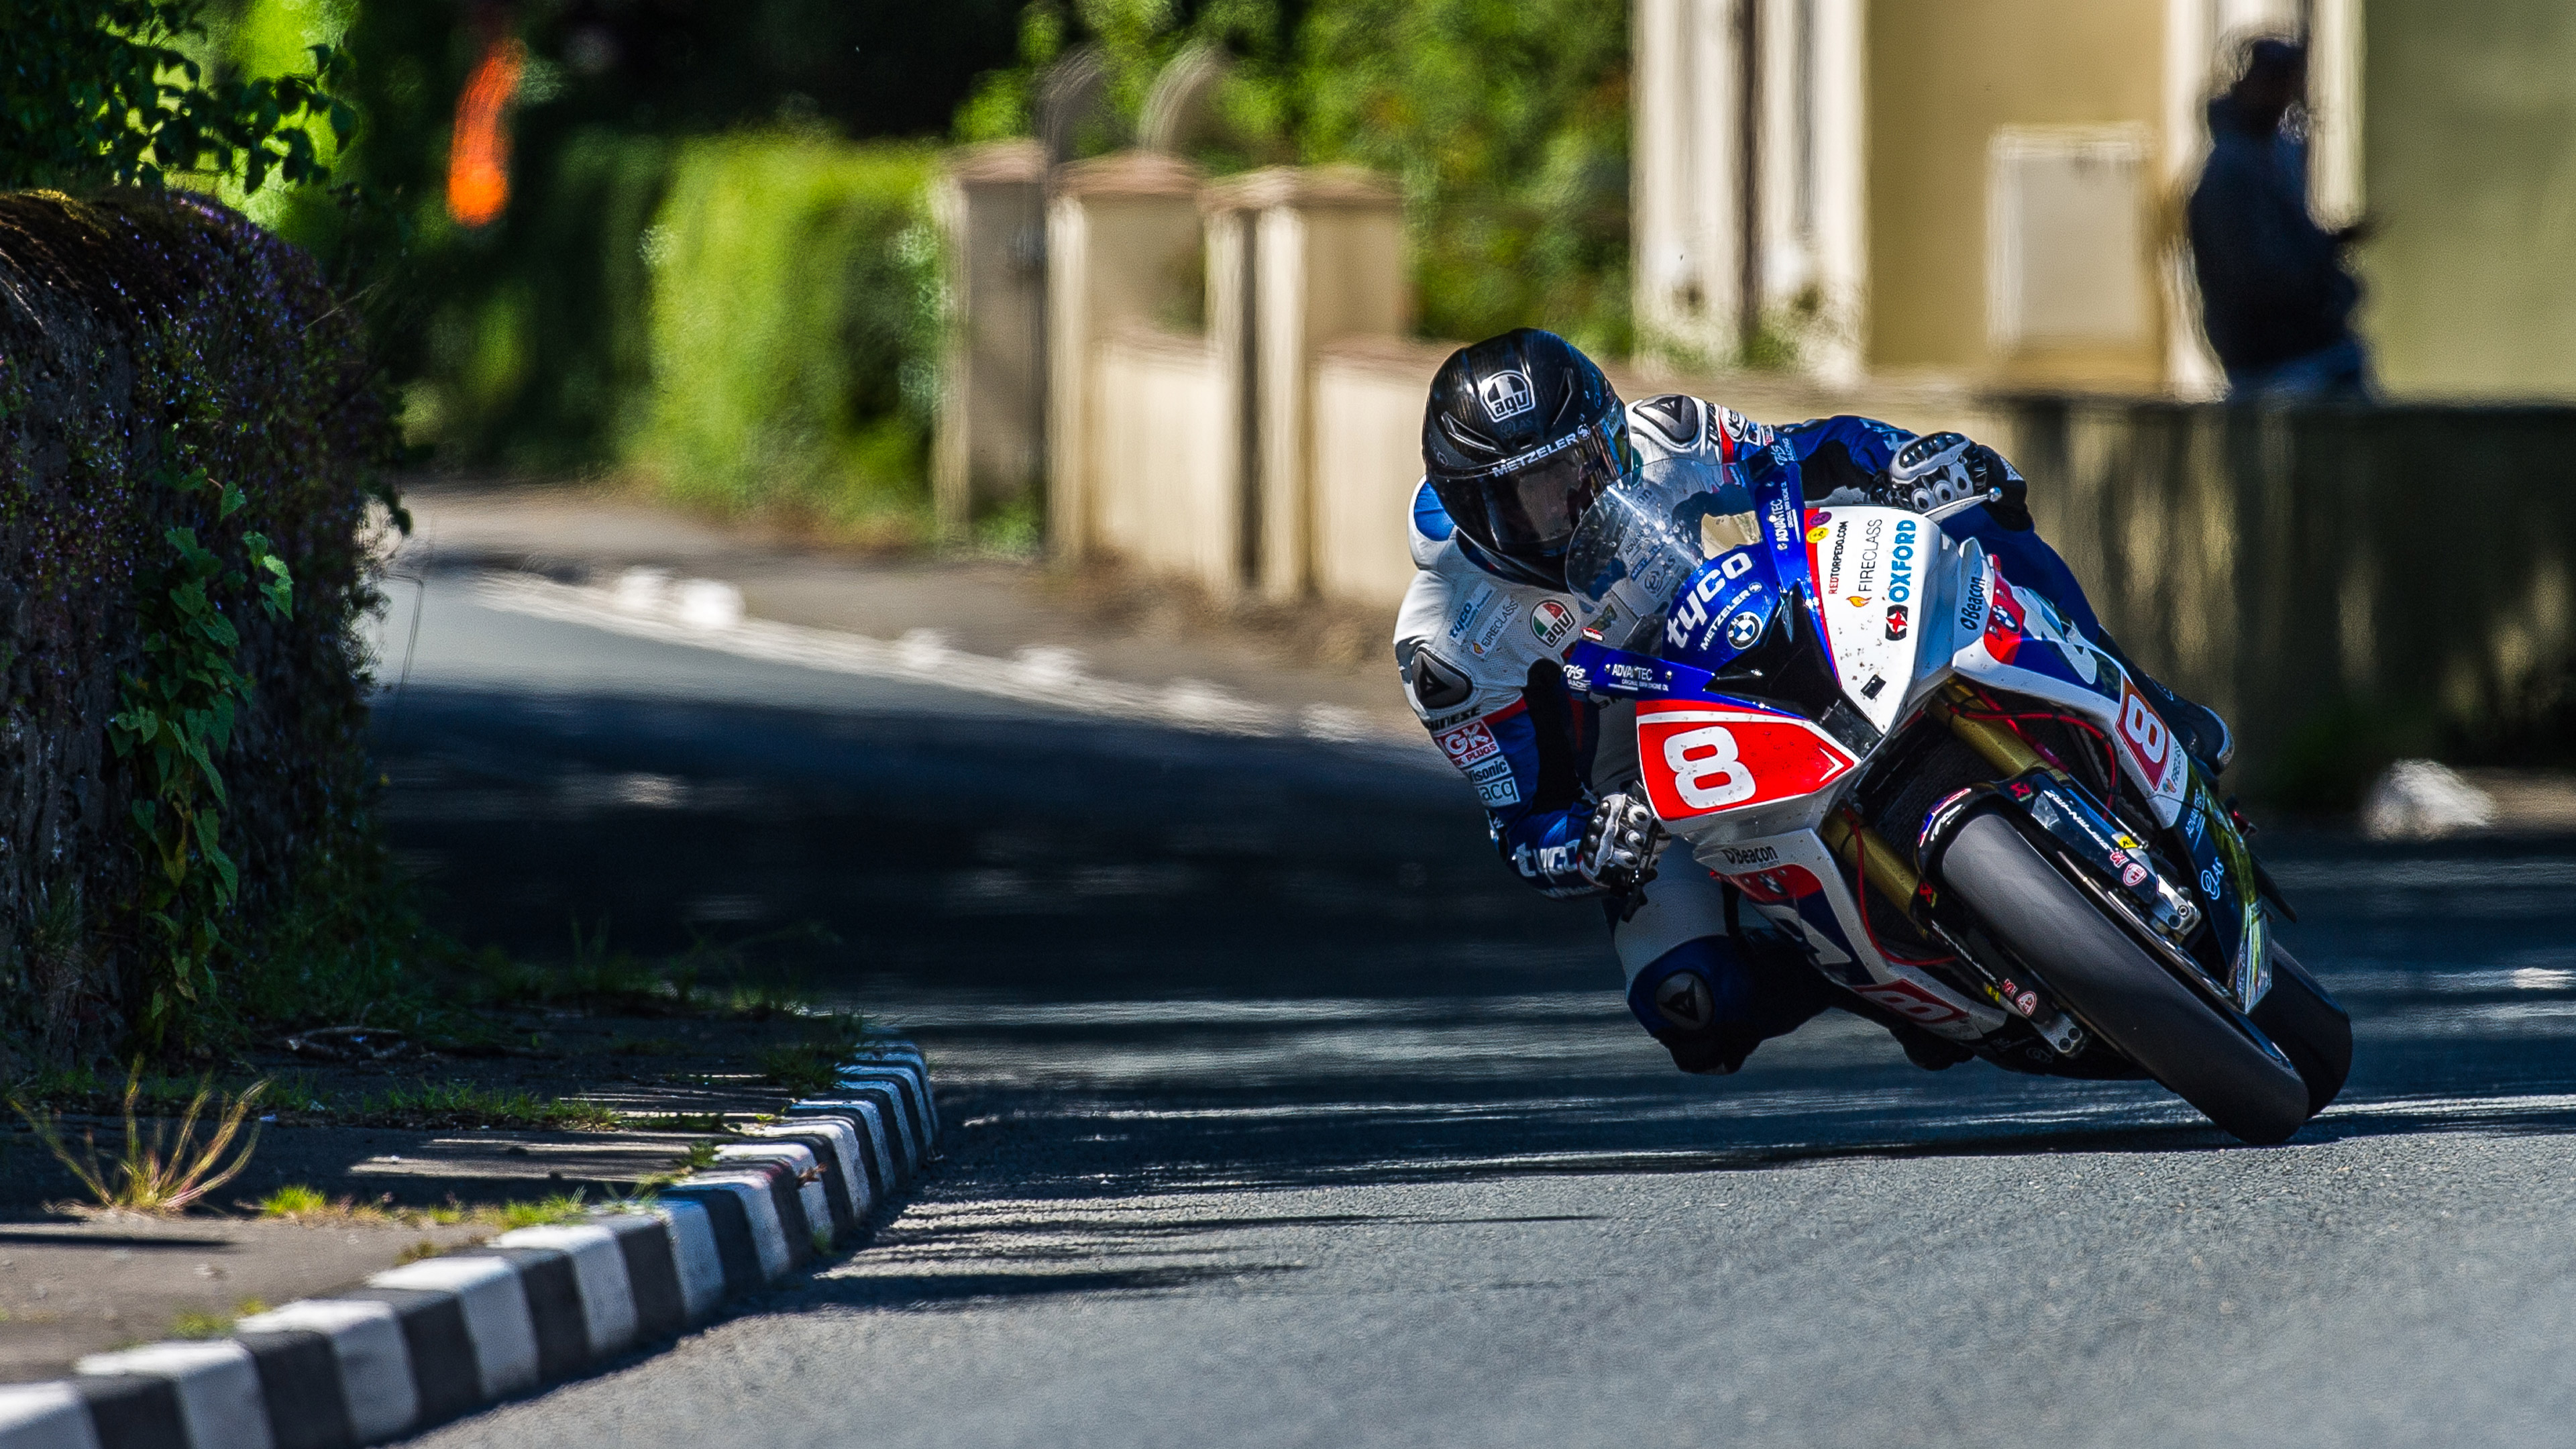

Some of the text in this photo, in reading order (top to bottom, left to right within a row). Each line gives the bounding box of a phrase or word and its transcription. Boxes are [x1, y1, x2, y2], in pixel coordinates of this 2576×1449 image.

[1494, 390, 1529, 415] agv
[1492, 433, 1578, 478] METZELER
[1858, 519, 1882, 592] FIRECLASS
[1888, 519, 1917, 602] OXFORD
[1450, 603, 1473, 639] tyco
[1481, 600, 1519, 647] FIRECLASS
[1667, 552, 1752, 649] tyco
[1700, 590, 1751, 651] METZELER
[1545, 613, 1571, 645] agv
[1438, 724, 1489, 755] GK
[2126, 694, 2166, 763] 8
[1465, 743, 1497, 762] PLUGS
[1664, 725, 1756, 809] 8
[1858, 989, 1955, 1022] 8
